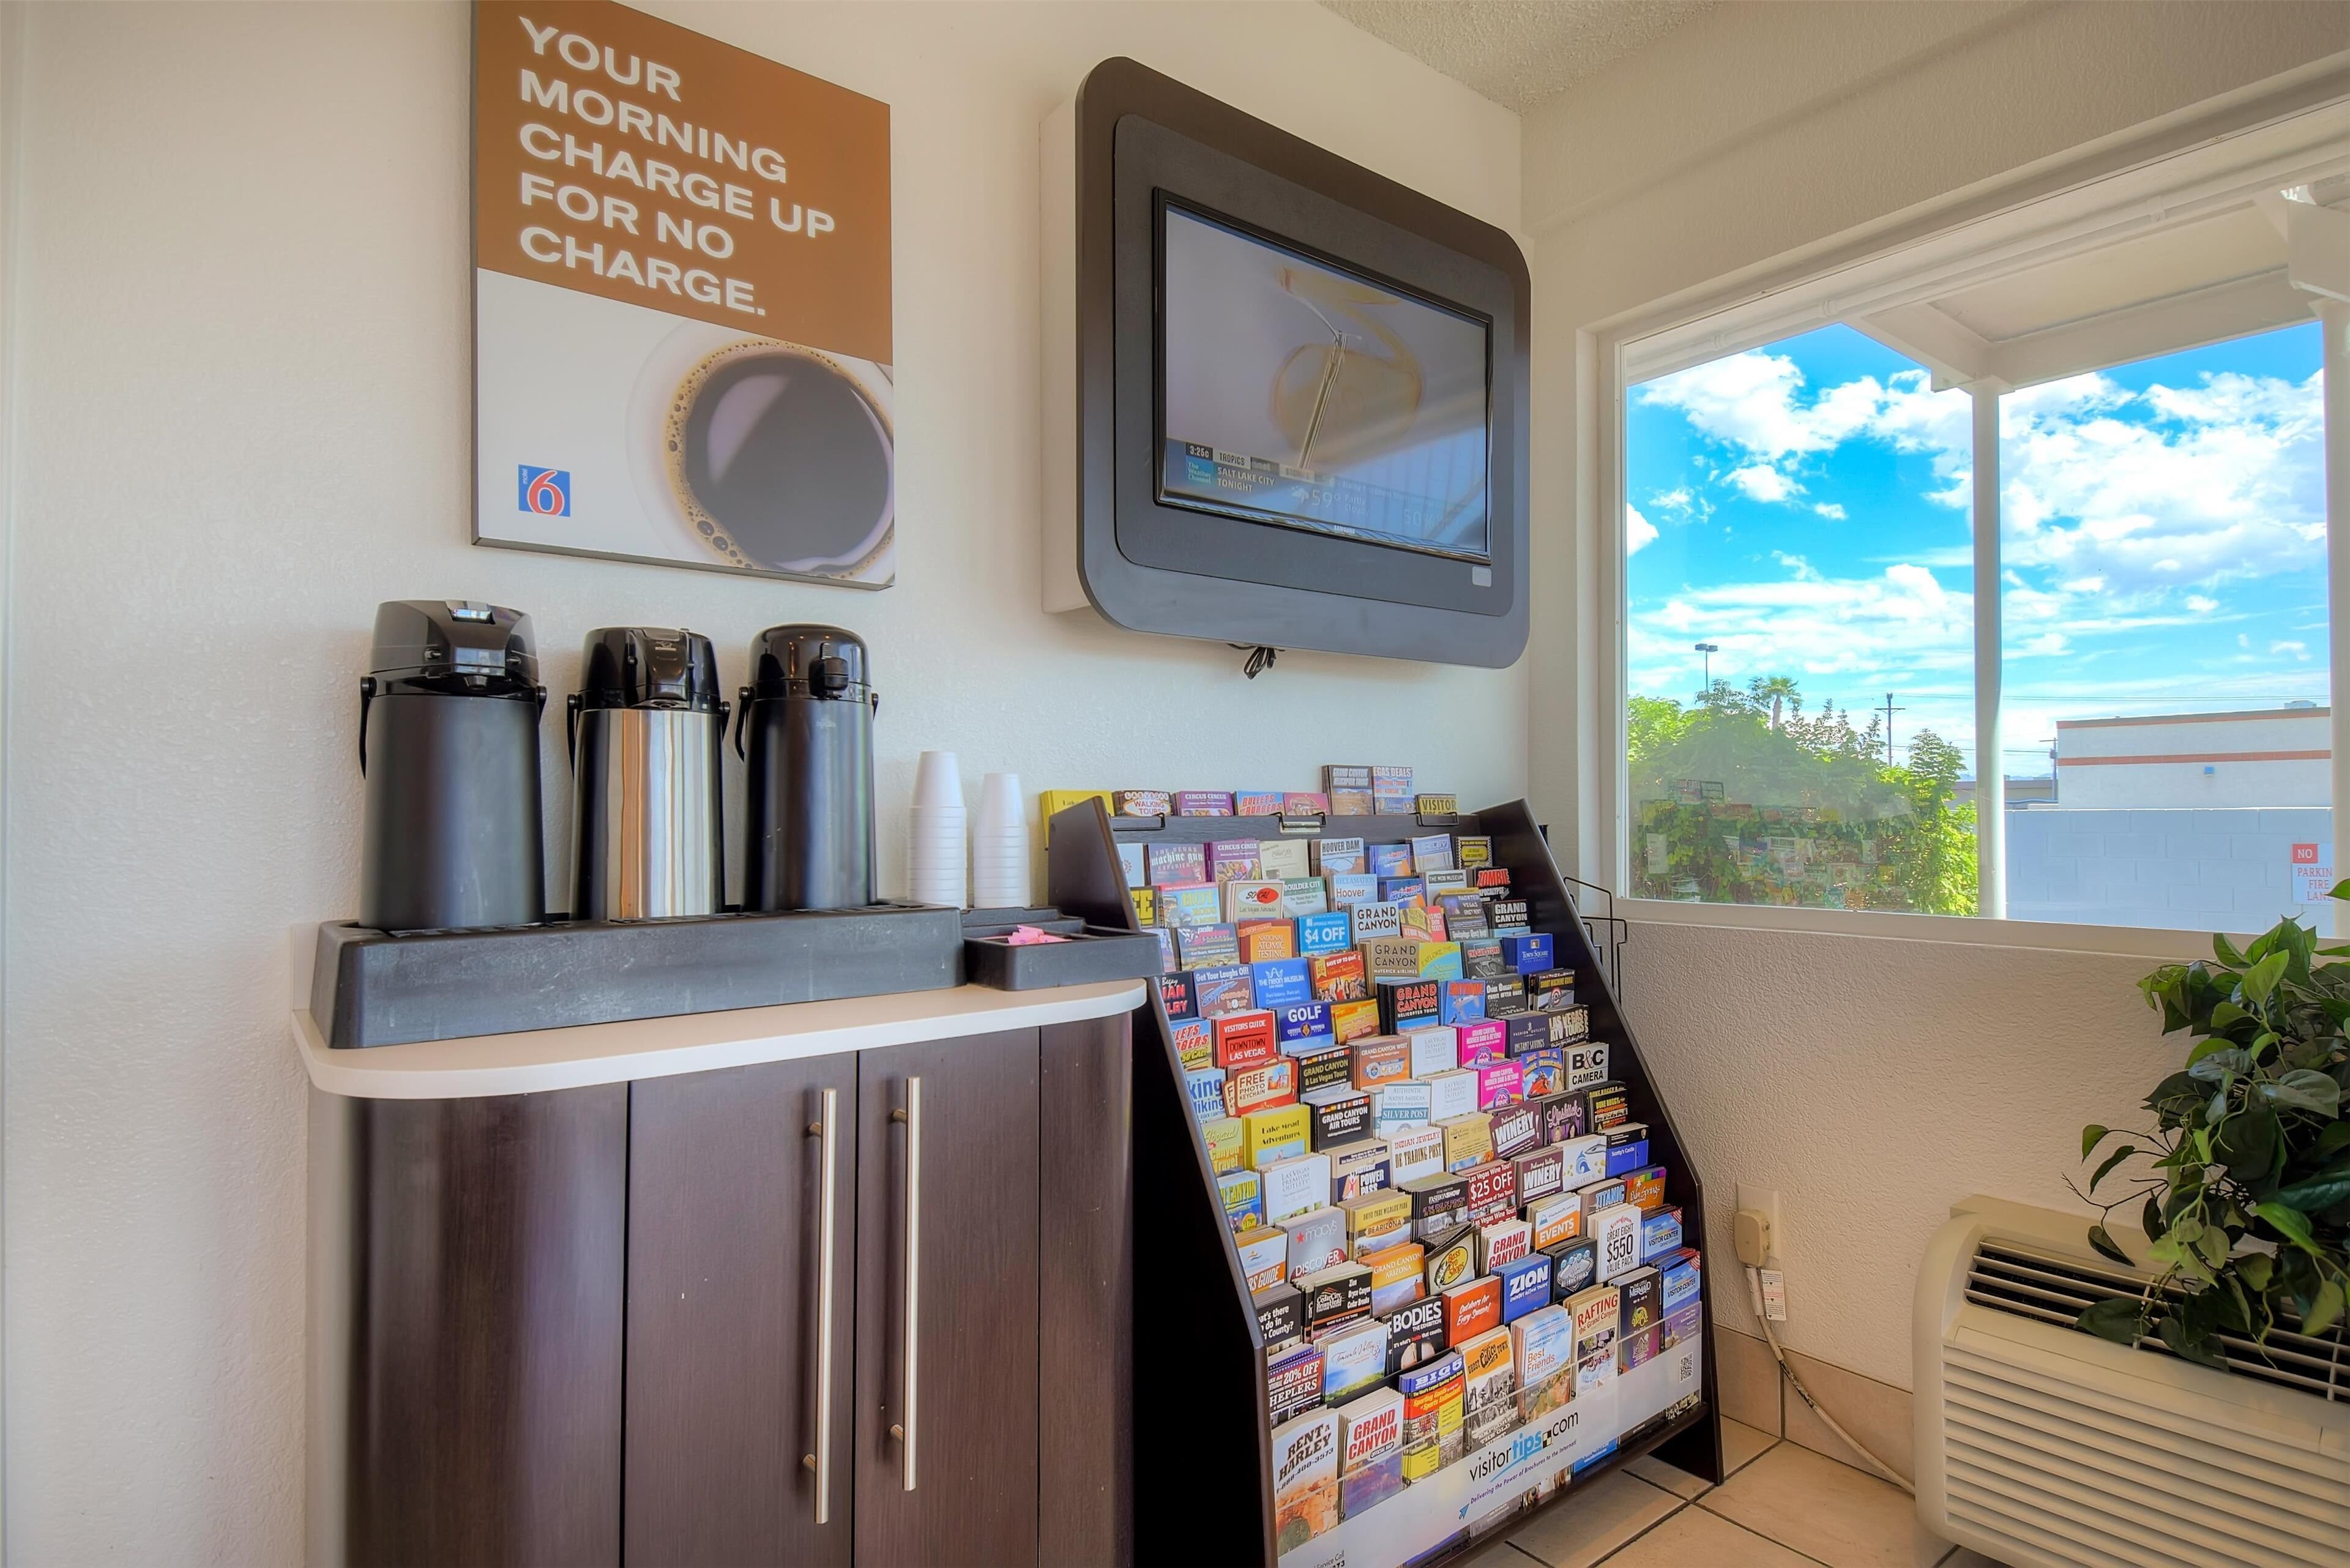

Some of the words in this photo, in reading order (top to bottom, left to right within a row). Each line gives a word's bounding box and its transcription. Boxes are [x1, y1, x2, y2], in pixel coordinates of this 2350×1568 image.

[518, 17, 681, 102] YOUR
[520, 70, 787, 184] MORNING
[520, 123, 754, 221] CHARGE
[770, 196, 835, 239] UP
[520, 173, 639, 235] FOR
[657, 212, 734, 259] NO
[520, 226, 766, 317] CHARGE.
[1219, 452, 1245, 466] TROPICS
[1187, 468, 1211, 478] Weather
[1188, 474, 1211, 483] Channel
[1217, 467, 1236, 477] SALT
[1237, 471, 1256, 482] LAKE
[1258, 476, 1275, 487] CITY
[528, 469, 565, 516] 6
[1218, 478, 1253, 493] TONIGHT
[1345, 494, 1365, 506] Partly
[1334, 525, 1356, 534] SAMSUNG
[1373, 767, 1390, 777] EGAS
[1390, 767, 1411, 777] DEALS
[1243, 794, 1275, 806] BULLETS
[1422, 799, 1457, 810] VISITOR
[1246, 803, 1283, 816] BURGERS
[1322, 842, 1345, 853] HOOVER
[1346, 840, 1360, 851] DAM
[2297, 849, 2313, 858] NO
[1477, 868, 1511, 887] ZOMBIE
[2297, 867, 2333, 877] PARKIN
[1284, 883, 1310, 892] BOULDER
[1336, 887, 1365, 898] Hoover
[1479, 887, 1505, 897] APOCALYPSE
[2308, 879, 2330, 889] FIRE
[1357, 906, 1397, 920] GRAND
[1495, 903, 1527, 914] GRAND
[1358, 919, 1397, 931] CANYON
[1495, 914, 1528, 923] CANYON
[1305, 928, 1319, 946] $4
[1322, 926, 1346, 942] OFF
[1375, 944, 1417, 955] GRAND
[1375, 957, 1417, 967] CANYON
[1397, 984, 1438, 1001] GRAND
[1288, 1005, 1322, 1023] GOLF
[1397, 997, 1438, 1014] CANYON
[1224, 1021, 1249, 1034] VISITORS
[1249, 1020, 1266, 1028] GUIDE
[1549, 1015, 1562, 1031] LAS
[1562, 1009, 1584, 1026] VEGAS
[1229, 1037, 1266, 1053] DOWNTOWN
[1229, 1051, 1243, 1061] LAS
[1244, 1048, 1266, 1059] VEGAS
[1573, 1049, 1604, 1070] B&C
[1304, 1065, 1324, 1077] GRAND
[1325, 1059, 1349, 1071] CANYON
[1239, 1072, 1265, 1088] FREE
[1572, 1070, 1603, 1085] CAMERA
[1239, 1083, 1265, 1095] PHOTO
[1239, 1089, 1265, 1101] KEYCHAIN
[1322, 1112, 1344, 1124] GRAND
[1344, 1106, 1368, 1118] CANYON
[1329, 1121, 1340, 1130] AIR
[1340, 1116, 1360, 1127] TOURS
[1382, 1110, 1409, 1119] SILVER
[1410, 1109, 1428, 1118] POST
[1495, 1111, 1534, 1144] WINERY
[1261, 1132, 1301, 1145] Adventures
[1395, 1137, 1416, 1149] INDIAN
[1416, 1131, 1440, 1144] JEWELRY
[1291, 1167, 1310, 1177] VEGAS
[1360, 1169, 1384, 1187] POWER
[1475, 1170, 1488, 1181] Vegas
[1490, 1166, 1501, 1175] Wine
[1501, 1162, 1512, 1171] Tour!
[1523, 1162, 1562, 1191] WINERY
[1228, 1179, 1258, 1204] CANYON
[1360, 1182, 1378, 1196] PASS
[1470, 1181, 1490, 1202] $25
[1493, 1171, 1513, 1190] OFF
[1595, 1184, 1625, 1208] TITANIC
[1368, 1219, 1401, 1235] BEARIZONA
[1539, 1218, 1575, 1244] EVENTS
[1607, 1228, 1619, 1242] GREAT
[1621, 1223, 1634, 1237] EIGHT
[1493, 1230, 1526, 1254] GRAND
[1648, 1235, 1663, 1247] VISITOR
[1663, 1230, 1679, 1242] CENTER
[1448, 1249, 1461, 1262] Bass
[1489, 1243, 1526, 1270] CANYON
[1607, 1234, 1633, 1263] $550
[1295, 1249, 1340, 1277] DISCOVER
[1373, 1261, 1396, 1275] GRAND
[1396, 1252, 1422, 1266] CANYON
[1386, 1264, 1412, 1279] ARIZONA
[1448, 1258, 1458, 1269] Pro
[1448, 1261, 1464, 1279] Shops
[1606, 1260, 1620, 1274] VALUE
[1621, 1256, 1633, 1268] PACK
[1258, 1266, 1280, 1289] GUIDE
[1509, 1264, 1549, 1296] ZION
[1667, 1285, 1683, 1298] VISITOR
[1682, 1278, 1696, 1291] CENTER
[1393, 1301, 1442, 1334] BODIES
[1577, 1293, 1618, 1328] RAFTING
[1587, 1316, 1600, 1331] Grand
[1600, 1308, 1617, 1323] Canyon
[1265, 1323, 1274, 1332] do
[1274, 1317, 1282, 1327] in
[1268, 1320, 1294, 1339] County?
[1468, 1357, 1480, 1375] GHOST
[1497, 1338, 1509, 1354] TOWN
[1527, 1352, 1556, 1375] Friends
[1528, 1347, 1545, 1364] Best
[1283, 1367, 1302, 1385] 20%
[1303, 1359, 1320, 1377] OFF
[1416, 1365, 1451, 1386] BIG
[1452, 1357, 1462, 1371] 5
[1269, 1378, 1318, 1408] HEPLERS
[1354, 1408, 1397, 1442] GRAND
[1288, 1423, 1324, 1460] RENT
[1348, 1423, 1398, 1460] CANYON
[1278, 1433, 1332, 1482] HARLEY
[1277, 1447, 1334, 1494] 1-888-400-3573
[1470, 1487, 1494, 1505] Delivering
[1494, 1479, 1503, 1491] the
[1503, 1473, 1518, 1487] Power
[1518, 1468, 1524, 1477] of
[1524, 1457, 1546, 1474] Brochures
[1559, 1439, 1577, 1454] Internet!
[1334, 1549, 1345, 1564] Call
